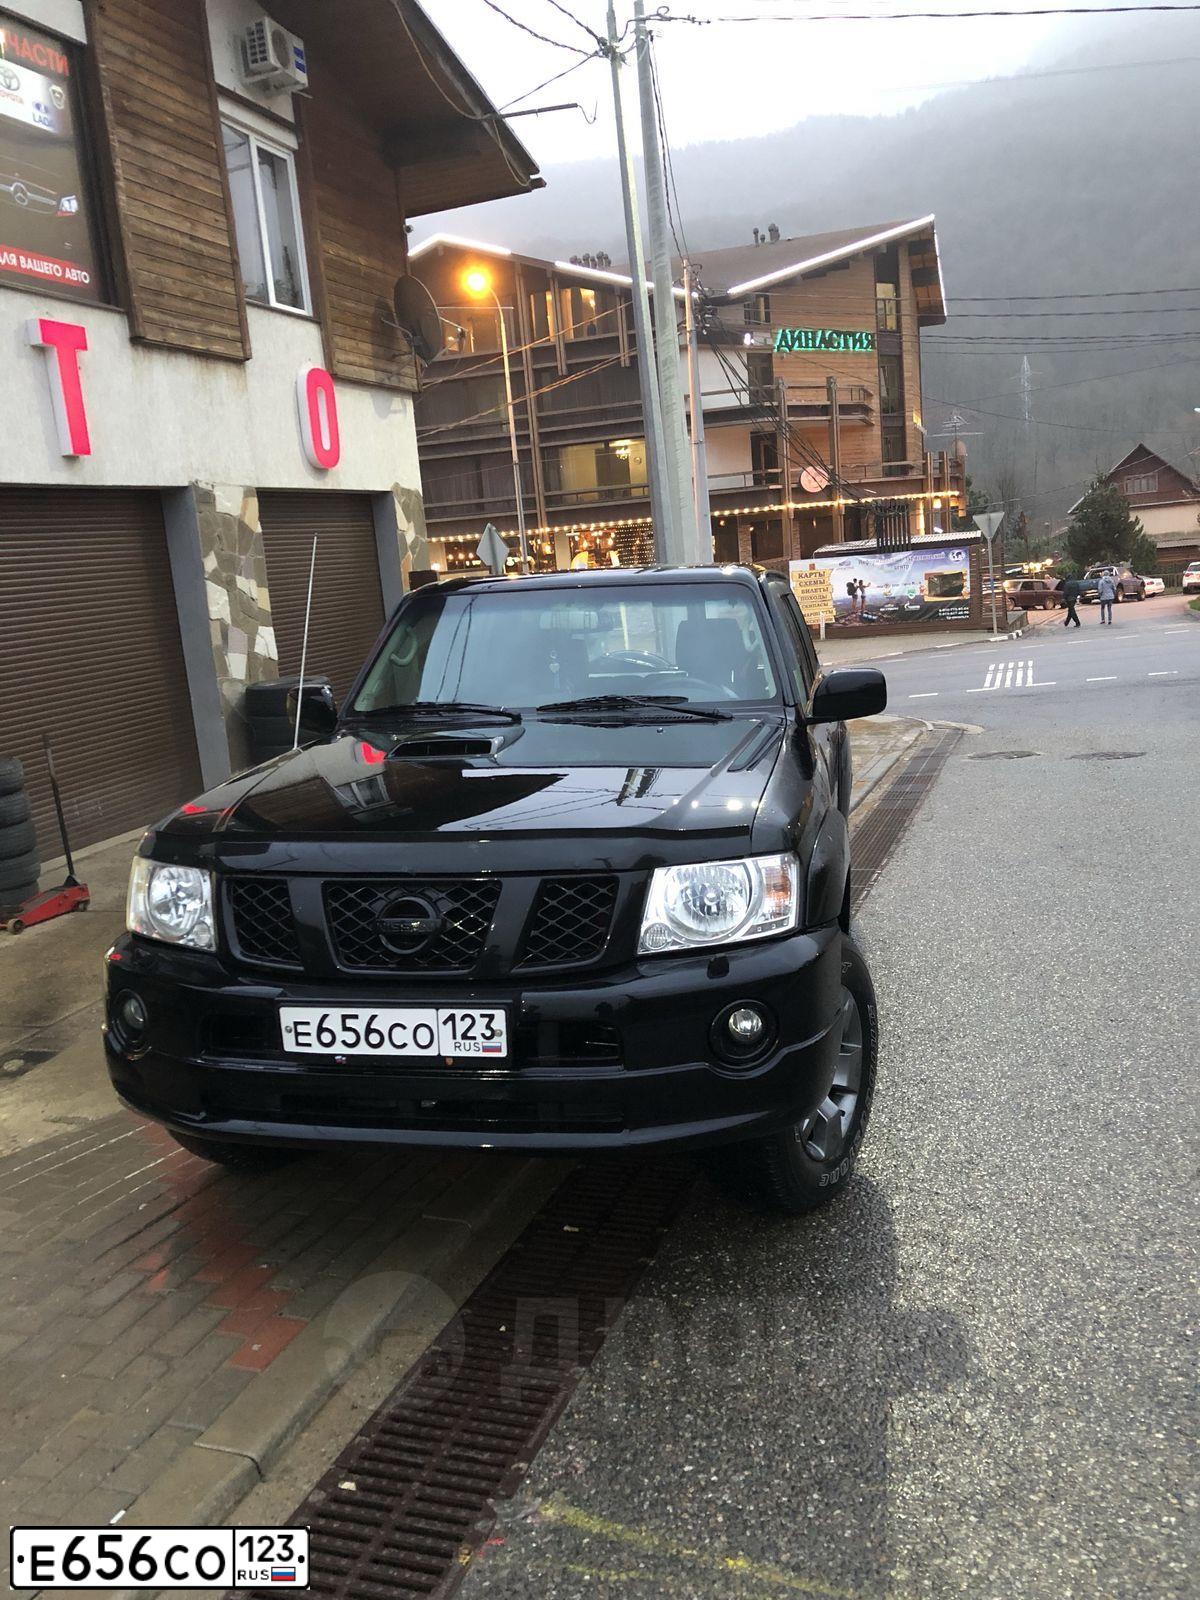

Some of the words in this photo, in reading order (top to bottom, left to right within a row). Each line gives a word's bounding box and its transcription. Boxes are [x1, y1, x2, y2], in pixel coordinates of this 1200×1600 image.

[19, 255, 62, 277] ВАШЕГО
[65, 267, 90, 284] АВТО
[773, 329, 875, 353] ДИНАСТИЯ
[798, 571, 825, 579] КАРТЫ
[799, 579, 825, 587] СХЕМЫ
[293, 1013, 435, 1050] Е656СО
[442, 1013, 496, 1041] 123
[454, 1042, 481, 1052] RUS
